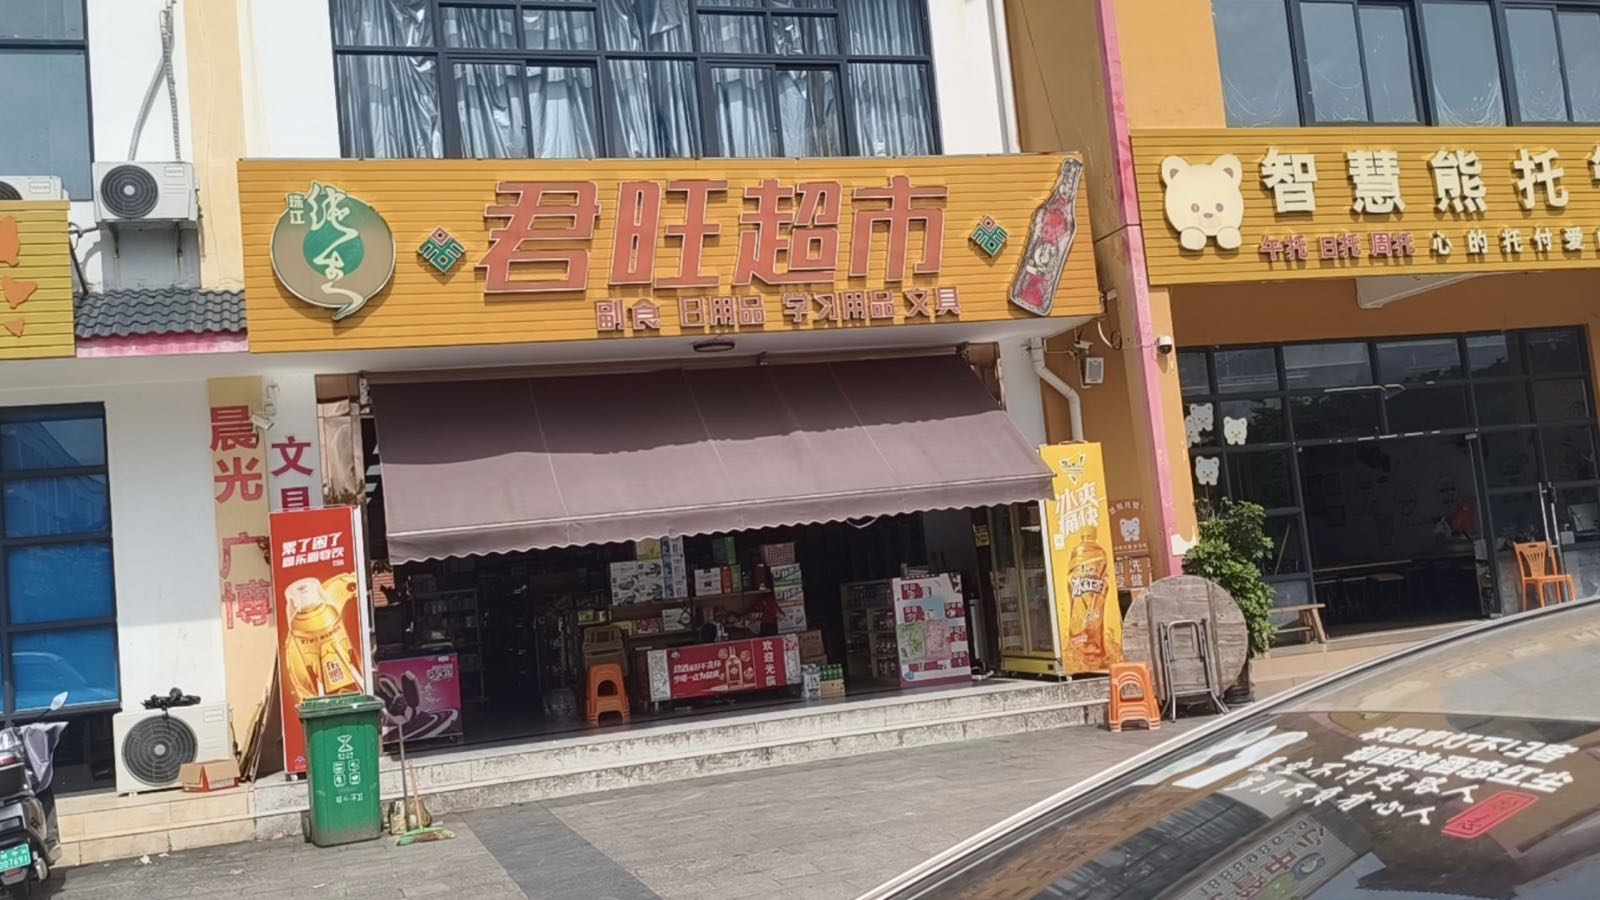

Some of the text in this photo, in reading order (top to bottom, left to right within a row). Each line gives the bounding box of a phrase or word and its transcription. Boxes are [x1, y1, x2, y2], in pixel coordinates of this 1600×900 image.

[474, 175, 949, 294] 君旺超市
[1260, 226, 1600, 262] 午托 日托 周托 心的托付爱
[596, 286, 960, 331] 副食 日用品 学习用品 文具
[210, 404, 272, 630] 晨光 广博
[1055, 482, 1099, 515] 冰爽
[1059, 504, 1099, 537] 痛快
[282, 532, 343, 556] 累了困了
[762, 640, 777, 687] 欢迎光临
[1359, 726, 1580, 764] 本是青灯不归客
[1343, 745, 1574, 793] 却因浊酒恋红尘
